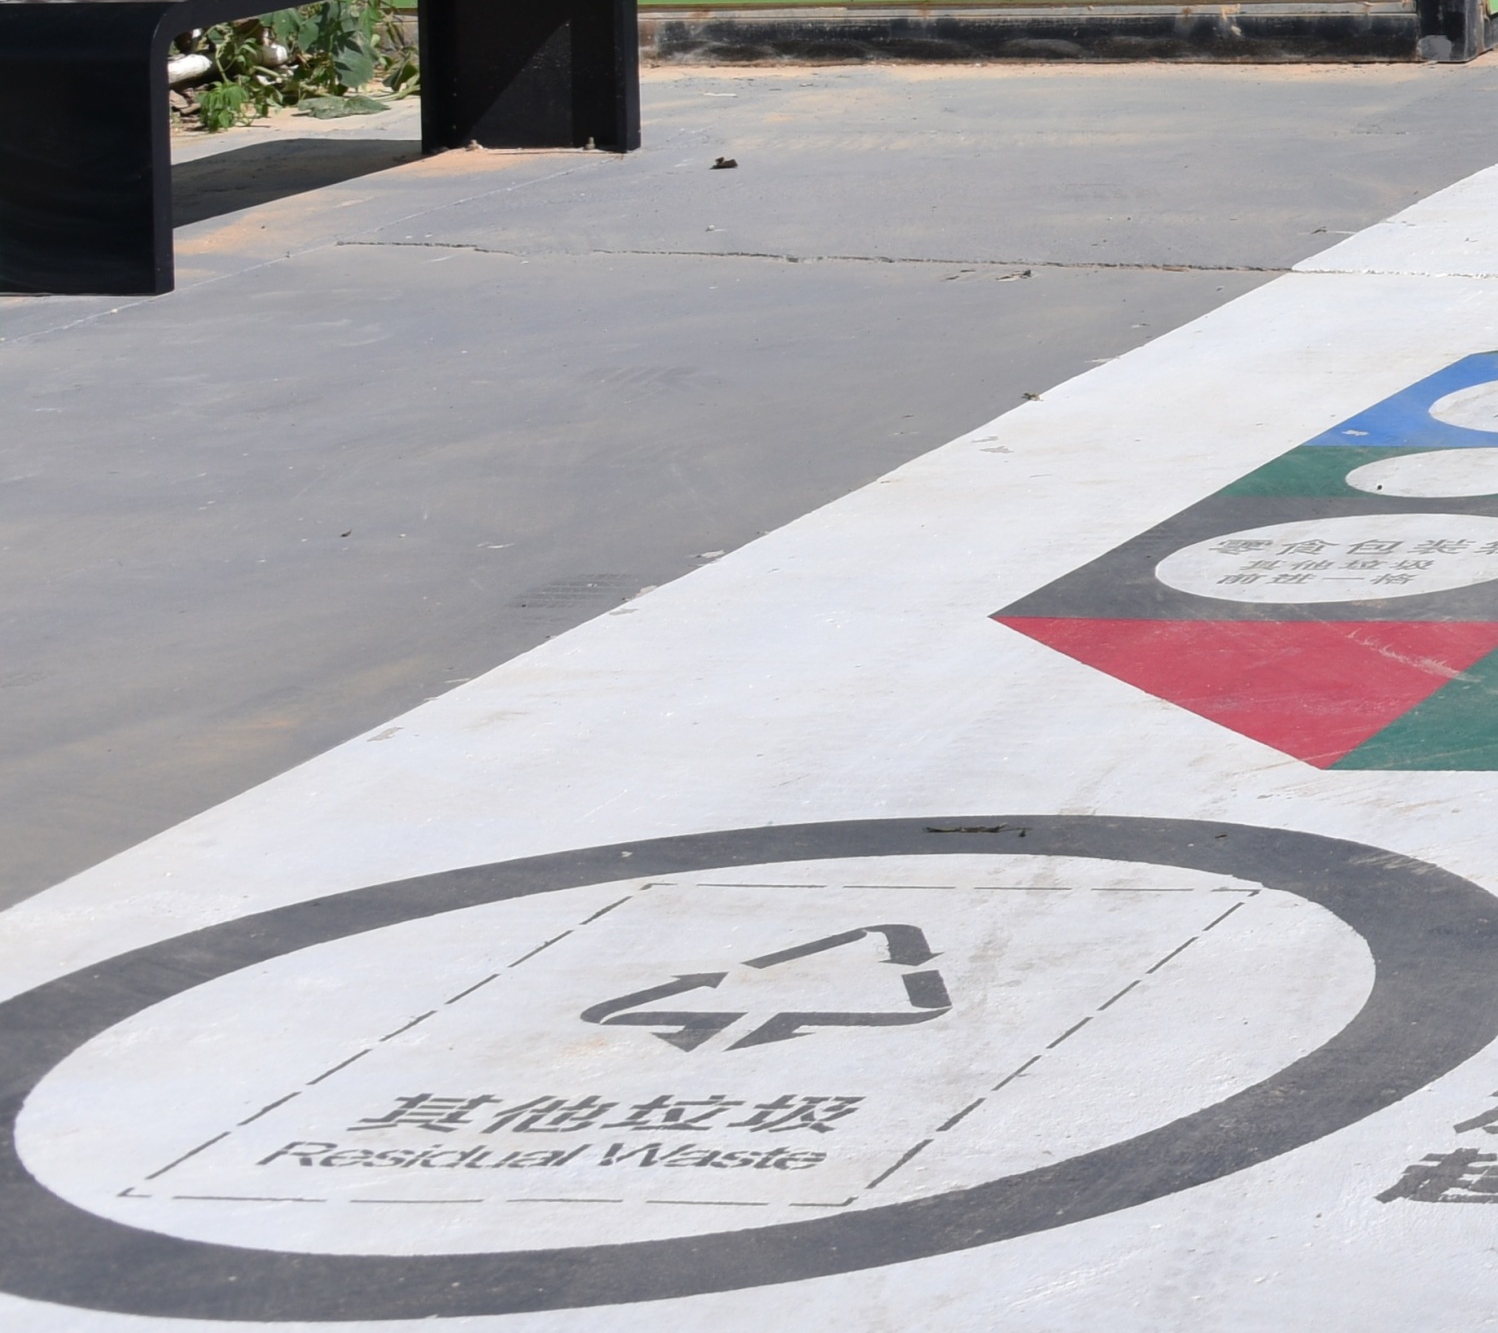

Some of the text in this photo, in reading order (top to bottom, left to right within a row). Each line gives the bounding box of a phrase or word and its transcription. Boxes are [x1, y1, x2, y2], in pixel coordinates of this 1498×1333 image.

[1240, 560, 1436, 572] 其他垃圾
[1216, 573, 1418, 587] 前进一格
[346, 1092, 864, 1134] 其他垃圾
[256, 1140, 827, 1172] Residual Waste
